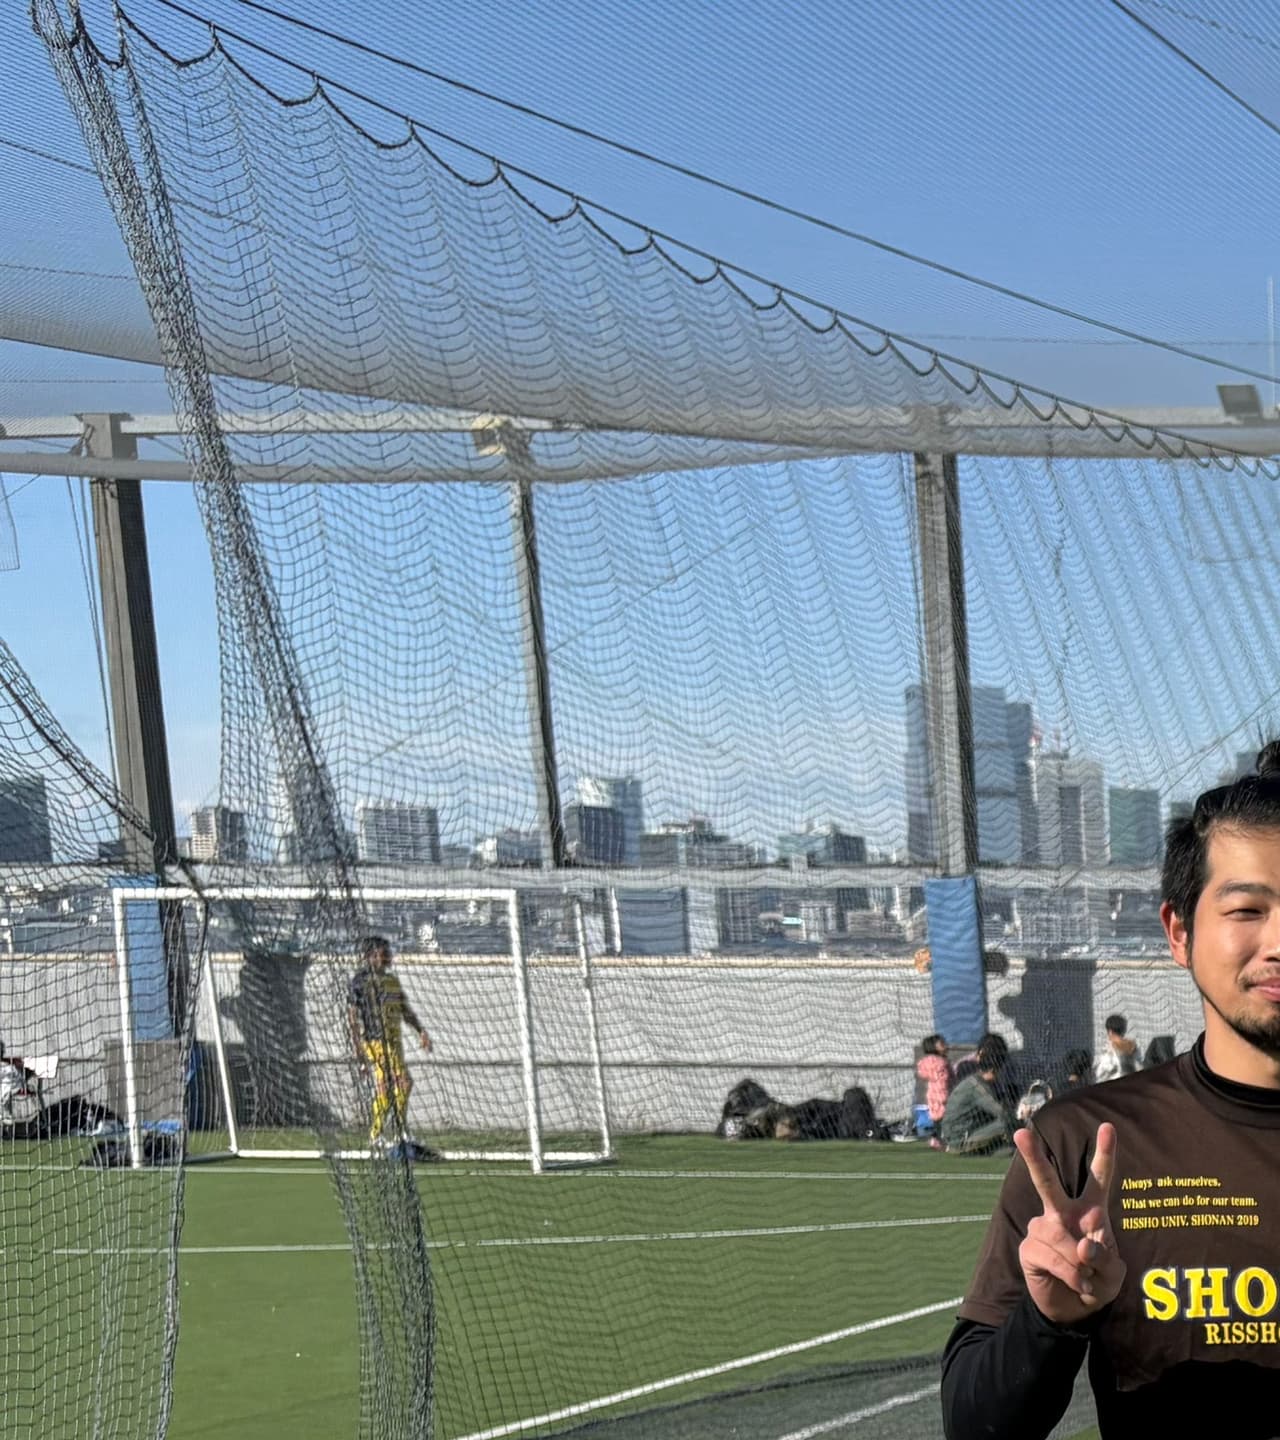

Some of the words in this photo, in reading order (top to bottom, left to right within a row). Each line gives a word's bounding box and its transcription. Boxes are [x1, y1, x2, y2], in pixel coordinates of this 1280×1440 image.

[1121, 1178, 1153, 1191] Always
[1157, 1176, 1174, 1187] ask
[1175, 1176, 1222, 1187] ourselves.
[1122, 1198, 1147, 1210] What
[1149, 1199, 1161, 1208] we
[1163, 1197, 1180, 1207] can
[1182, 1195, 1194, 1206] do
[1196, 1195, 1210, 1206] for
[1212, 1197, 1229, 1206] our
[1231, 1196, 1258, 1207] team.
[1122, 1217, 1159, 1230] RISSHO
[1161, 1215, 1189, 1228] UNIV.
[1191, 1214, 1235, 1227] SHONAN
